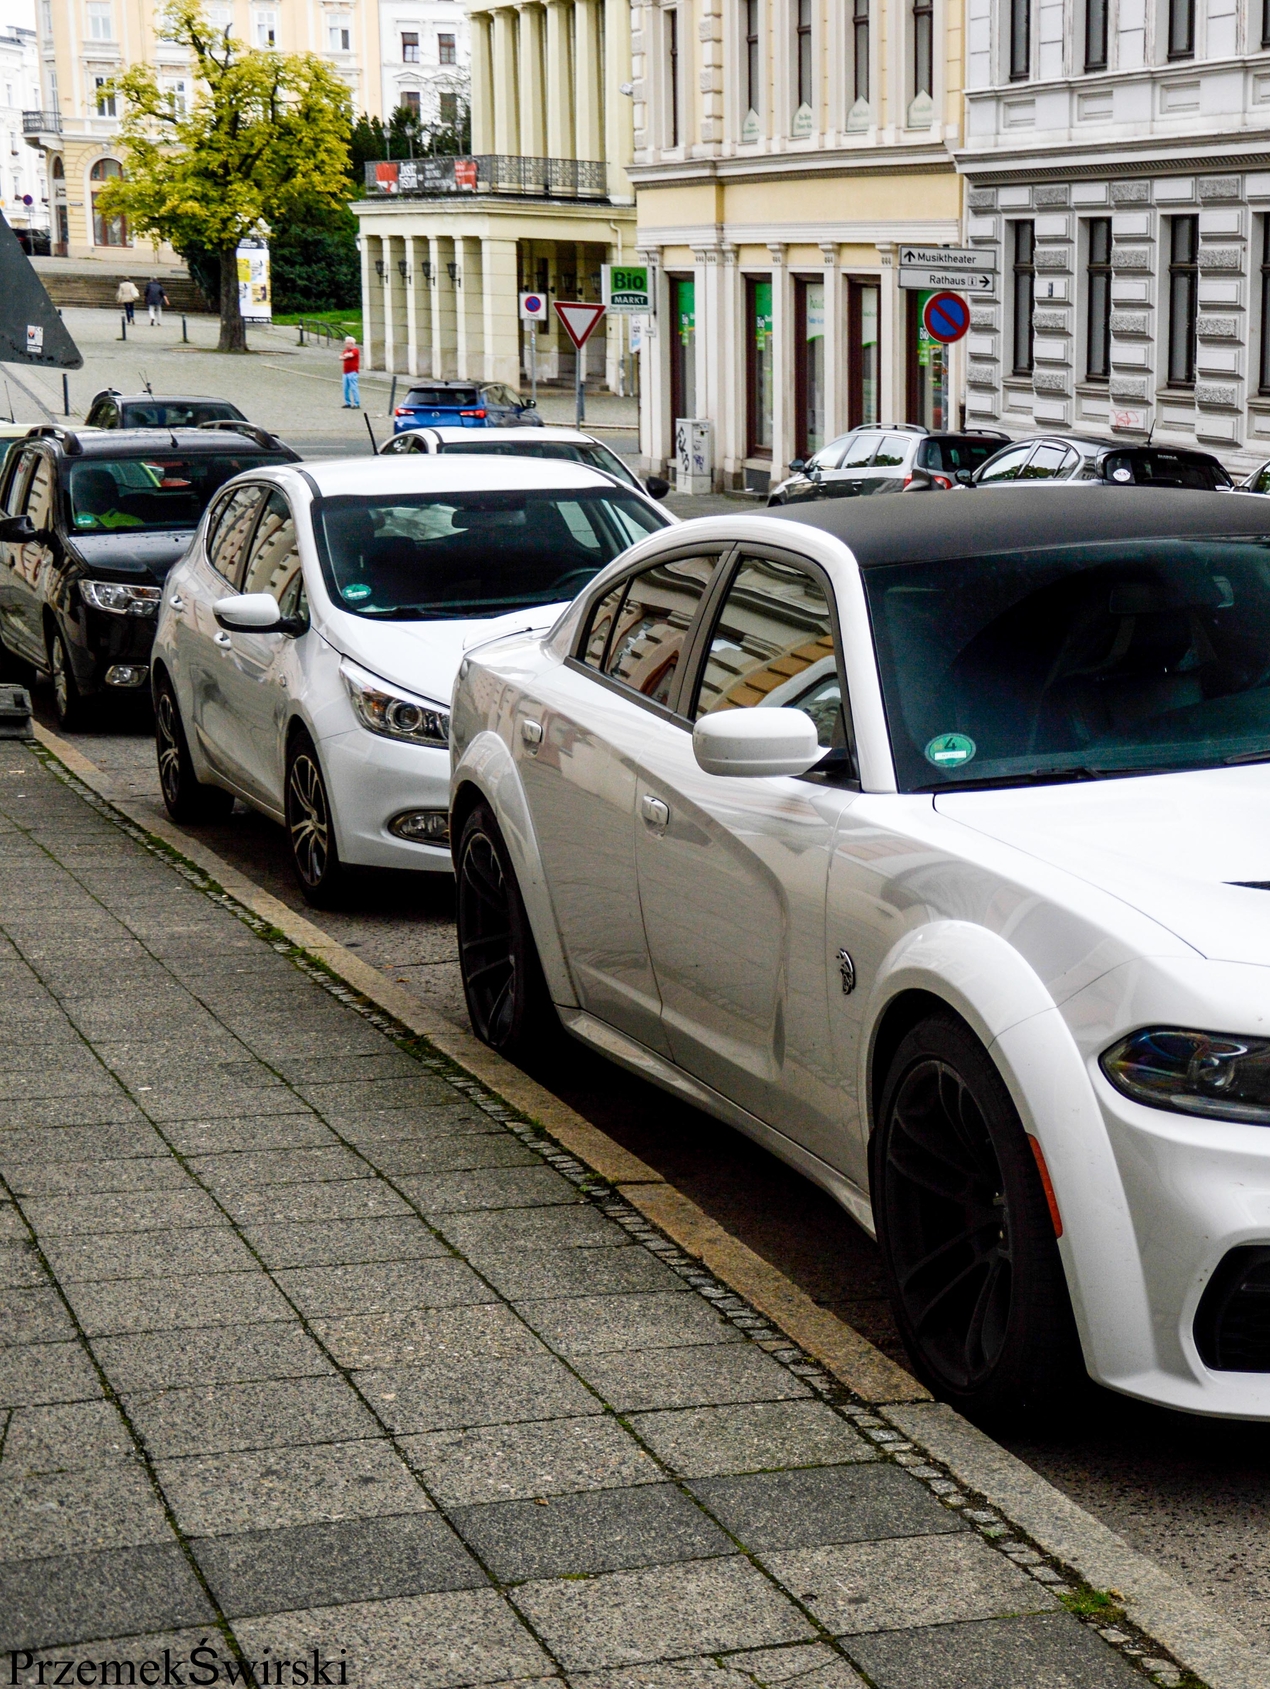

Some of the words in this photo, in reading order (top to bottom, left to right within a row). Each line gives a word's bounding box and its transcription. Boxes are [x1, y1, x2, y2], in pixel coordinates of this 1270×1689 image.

[917, 252, 977, 264] Musiktheater
[613, 271, 645, 290] Bio
[929, 275, 966, 286] Rathaus
[614, 295, 645, 304] MARKT
